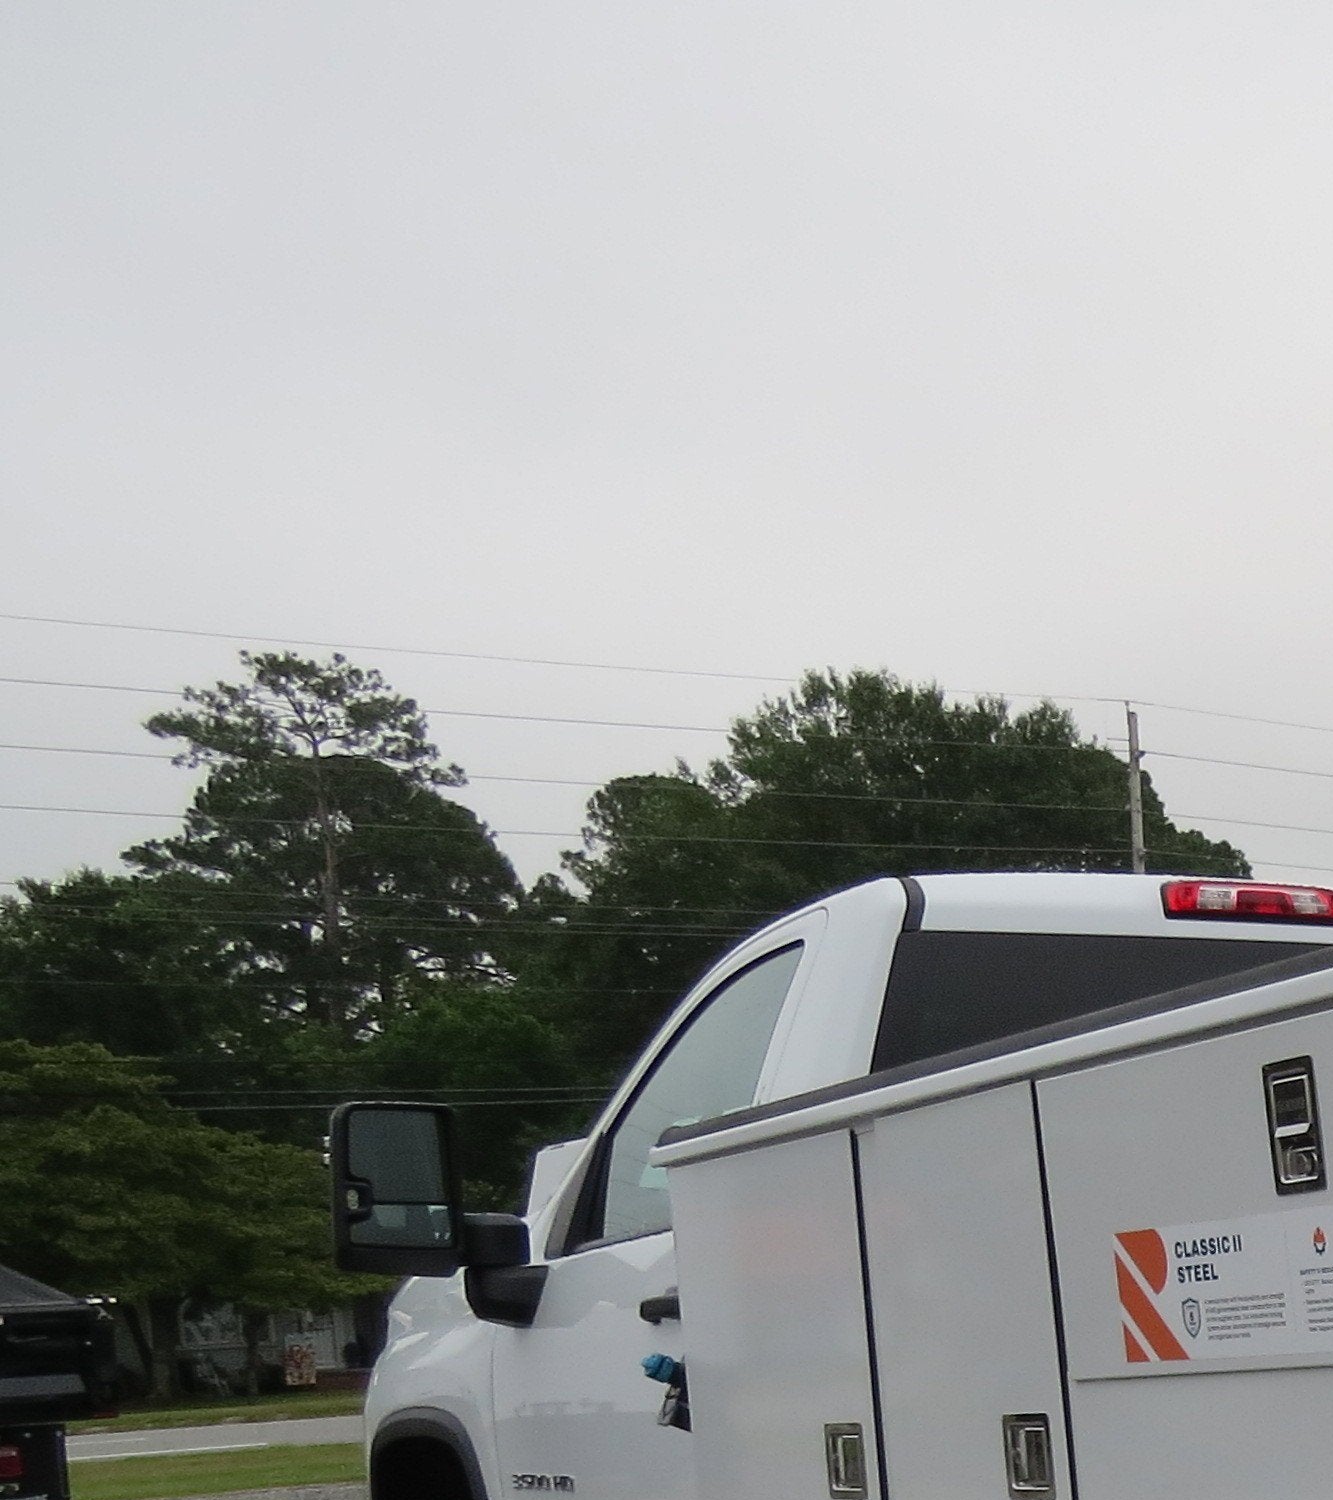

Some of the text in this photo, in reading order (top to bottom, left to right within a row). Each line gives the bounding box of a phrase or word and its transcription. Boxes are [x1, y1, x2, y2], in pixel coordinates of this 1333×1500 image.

[1174, 1234, 1243, 1259] CLASSIC II
[1177, 1263, 1220, 1284] STEEL
